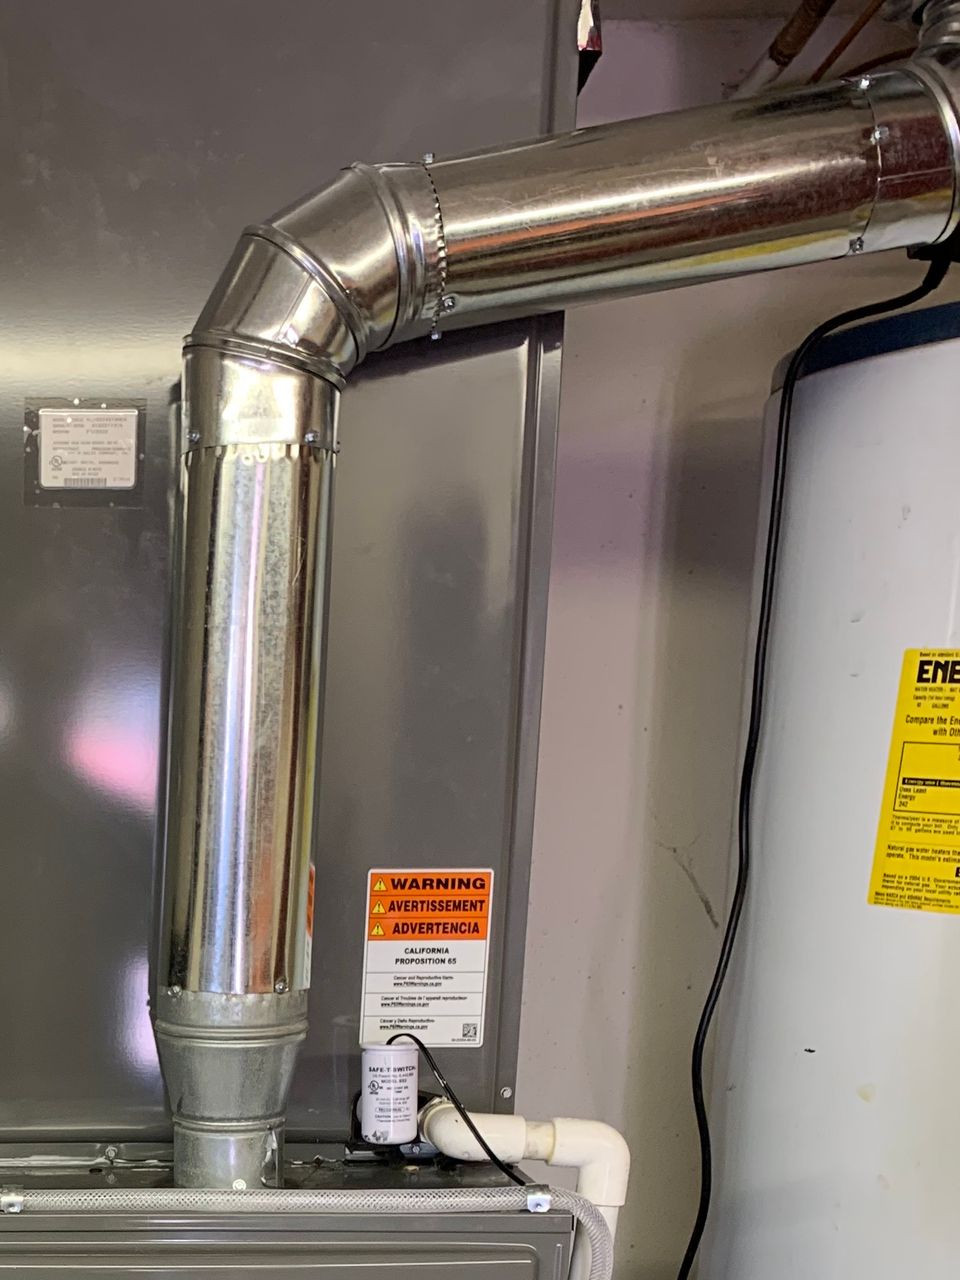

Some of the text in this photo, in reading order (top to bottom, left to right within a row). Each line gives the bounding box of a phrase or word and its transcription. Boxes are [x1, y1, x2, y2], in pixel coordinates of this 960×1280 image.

[906, 714, 934, 726] Compare
[936, 716, 948, 725] the
[933, 728, 948, 736] with
[390, 878, 486, 890] WARNING
[388, 900, 486, 912] AVERTISSEMENT
[392, 922, 480, 934] ADVERTENCIA
